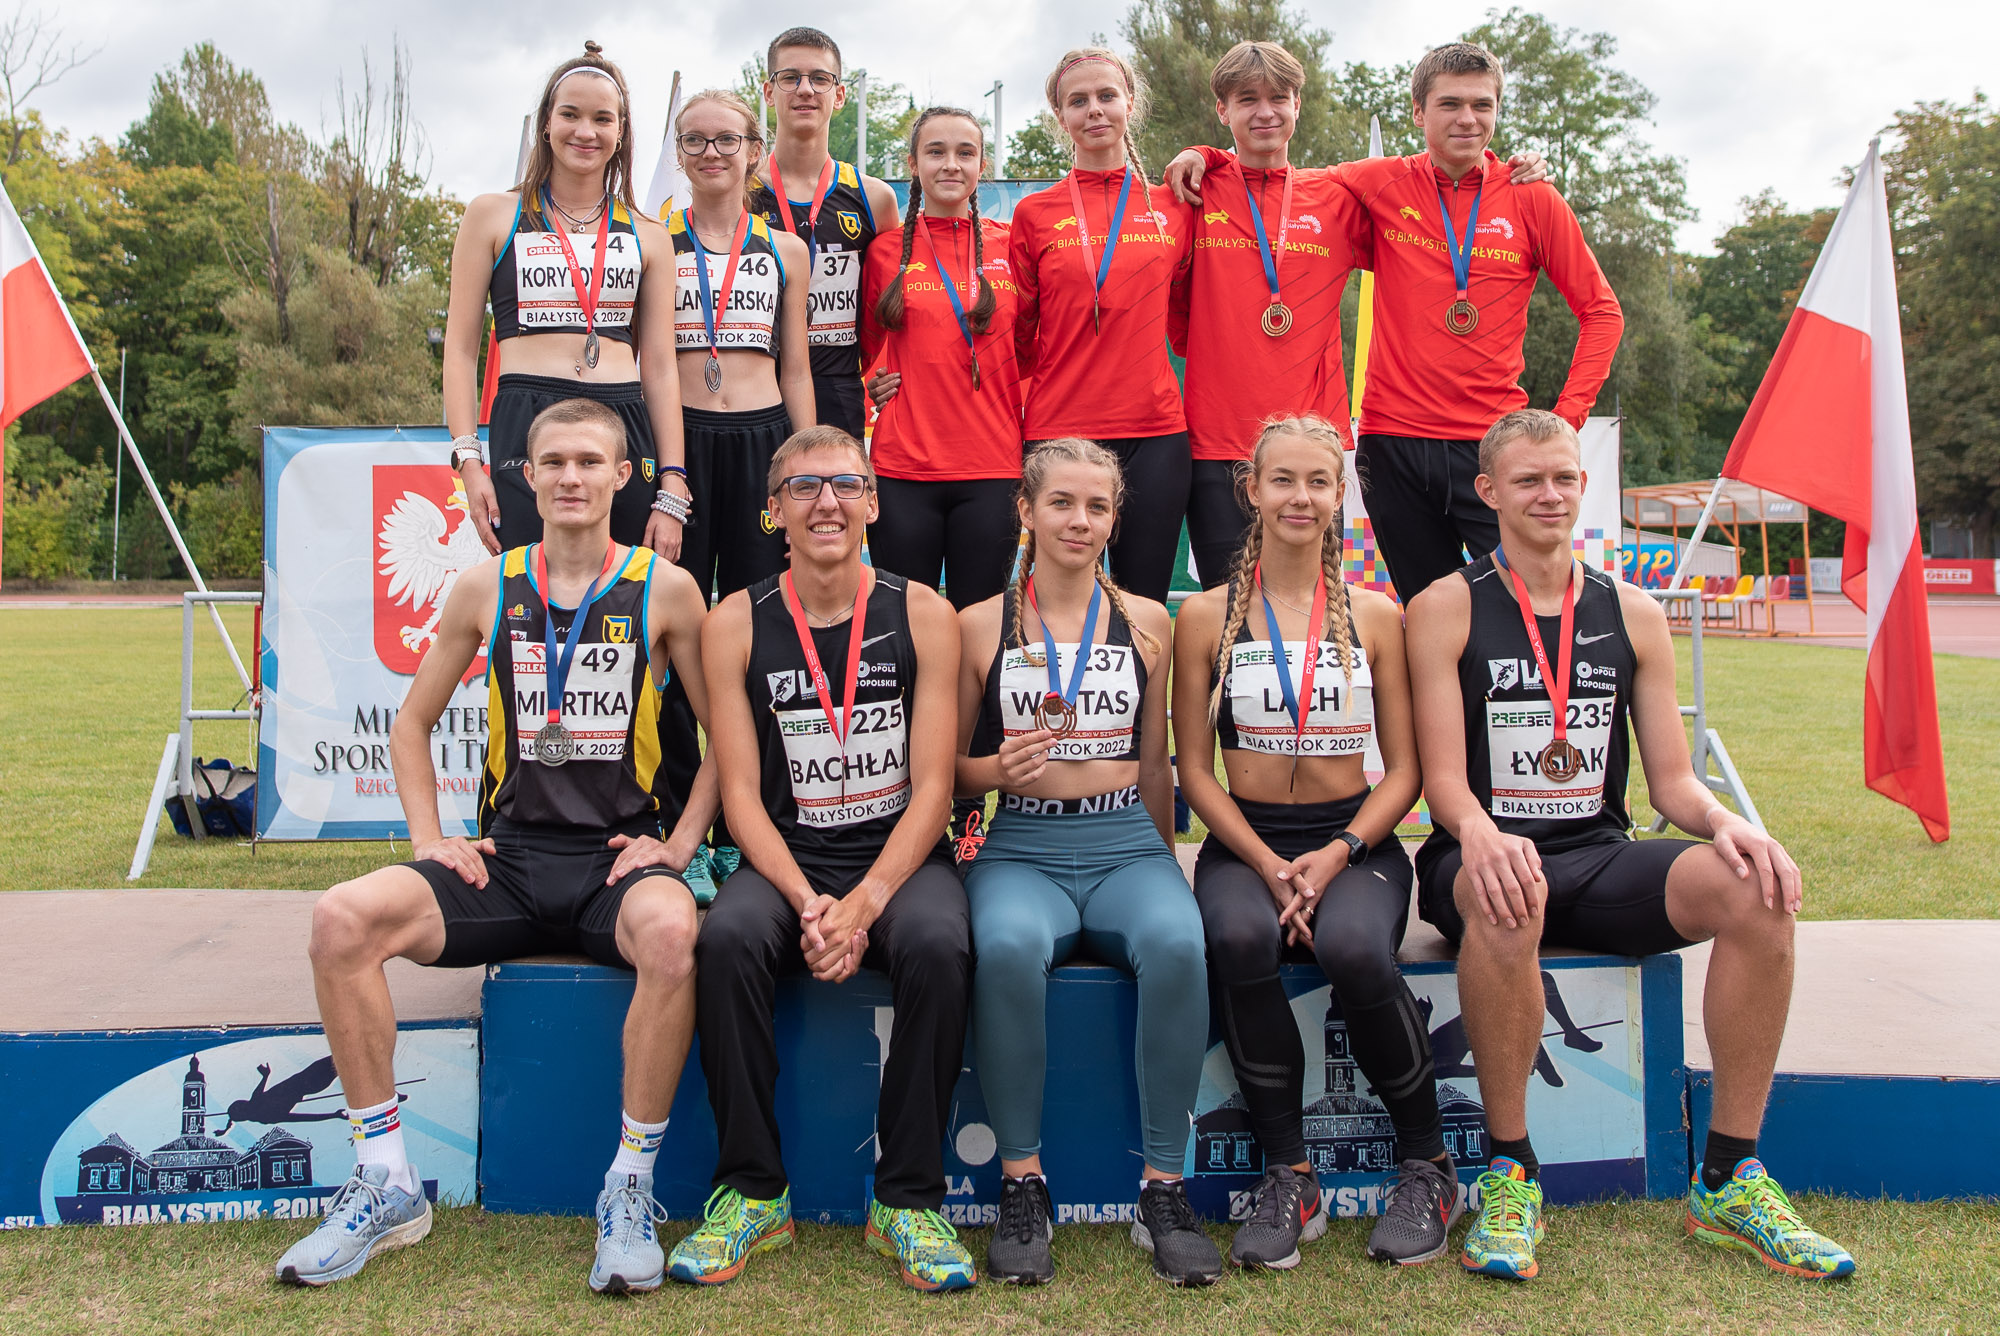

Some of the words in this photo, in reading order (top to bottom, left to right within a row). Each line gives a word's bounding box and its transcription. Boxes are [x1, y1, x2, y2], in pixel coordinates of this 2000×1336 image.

[528, 246, 563, 255] ORLEN
[591, 236, 624, 253] 4
[1057, 235, 1119, 249] BIAŁSTO
[1205, 237, 1260, 249] BIAŁYSTO
[1272, 240, 1330, 258] BAŁYSTOK
[1396, 232, 1449, 253] BIAŁYSTO
[1458, 245, 1521, 265] BAŁYSTOK
[679, 268, 713, 277] ORLN
[738, 256, 769, 276] 46
[823, 255, 850, 276] 37
[906, 281, 967, 293] PODLAIE
[527, 312, 599, 323] BIAŁYSTOK
[601, 311, 627, 322] 2022
[581, 647, 620, 673] 49
[1534, 640, 1545, 664] PZLA
[513, 664, 547, 673] ORLEN
[870, 665, 896, 673] OPOLE
[1305, 652, 1315, 675] PZLA
[1592, 668, 1616, 677] OPOLE
[813, 666, 825, 690] PZLA
[859, 679, 897, 688] OPOLSKIE
[1581, 681, 1617, 692] OPOLSKIE
[517, 690, 629, 716] MIRTKA
[1010, 690, 1130, 716] WTAS
[851, 703, 902, 735] 225
[1566, 701, 1613, 730] 235
[781, 717, 836, 735] PREFBE
[590, 743, 624, 755] 2022
[1096, 739, 1125, 755] 2022
[1329, 737, 1364, 751] 2022
[790, 742, 906, 785] BACHŁAJ
[879, 791, 908, 813] 2022
[1005, 793, 1064, 815] PRO
[1501, 801, 1584, 814] BIAŁYSTOK
